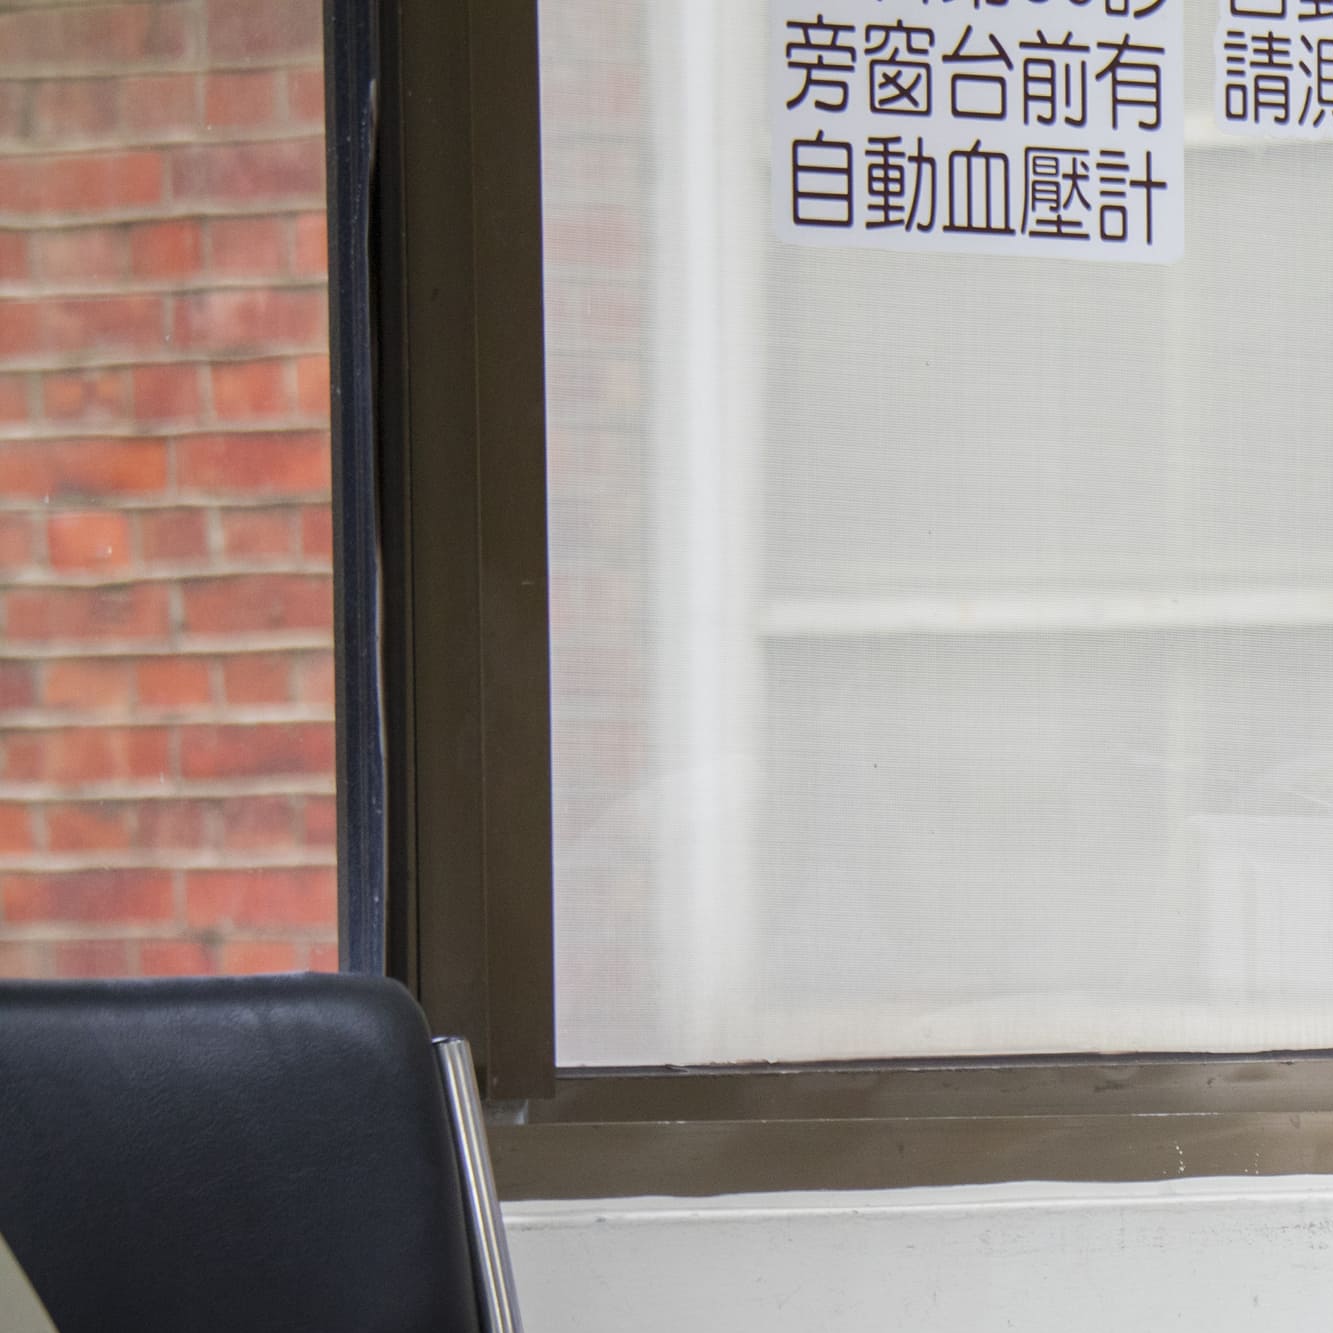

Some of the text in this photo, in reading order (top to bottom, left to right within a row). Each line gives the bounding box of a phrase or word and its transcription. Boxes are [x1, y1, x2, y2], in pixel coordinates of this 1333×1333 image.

[785, 14, 1166, 130] 旁窗台前有
[791, 130, 1168, 245] 自動血壓計
